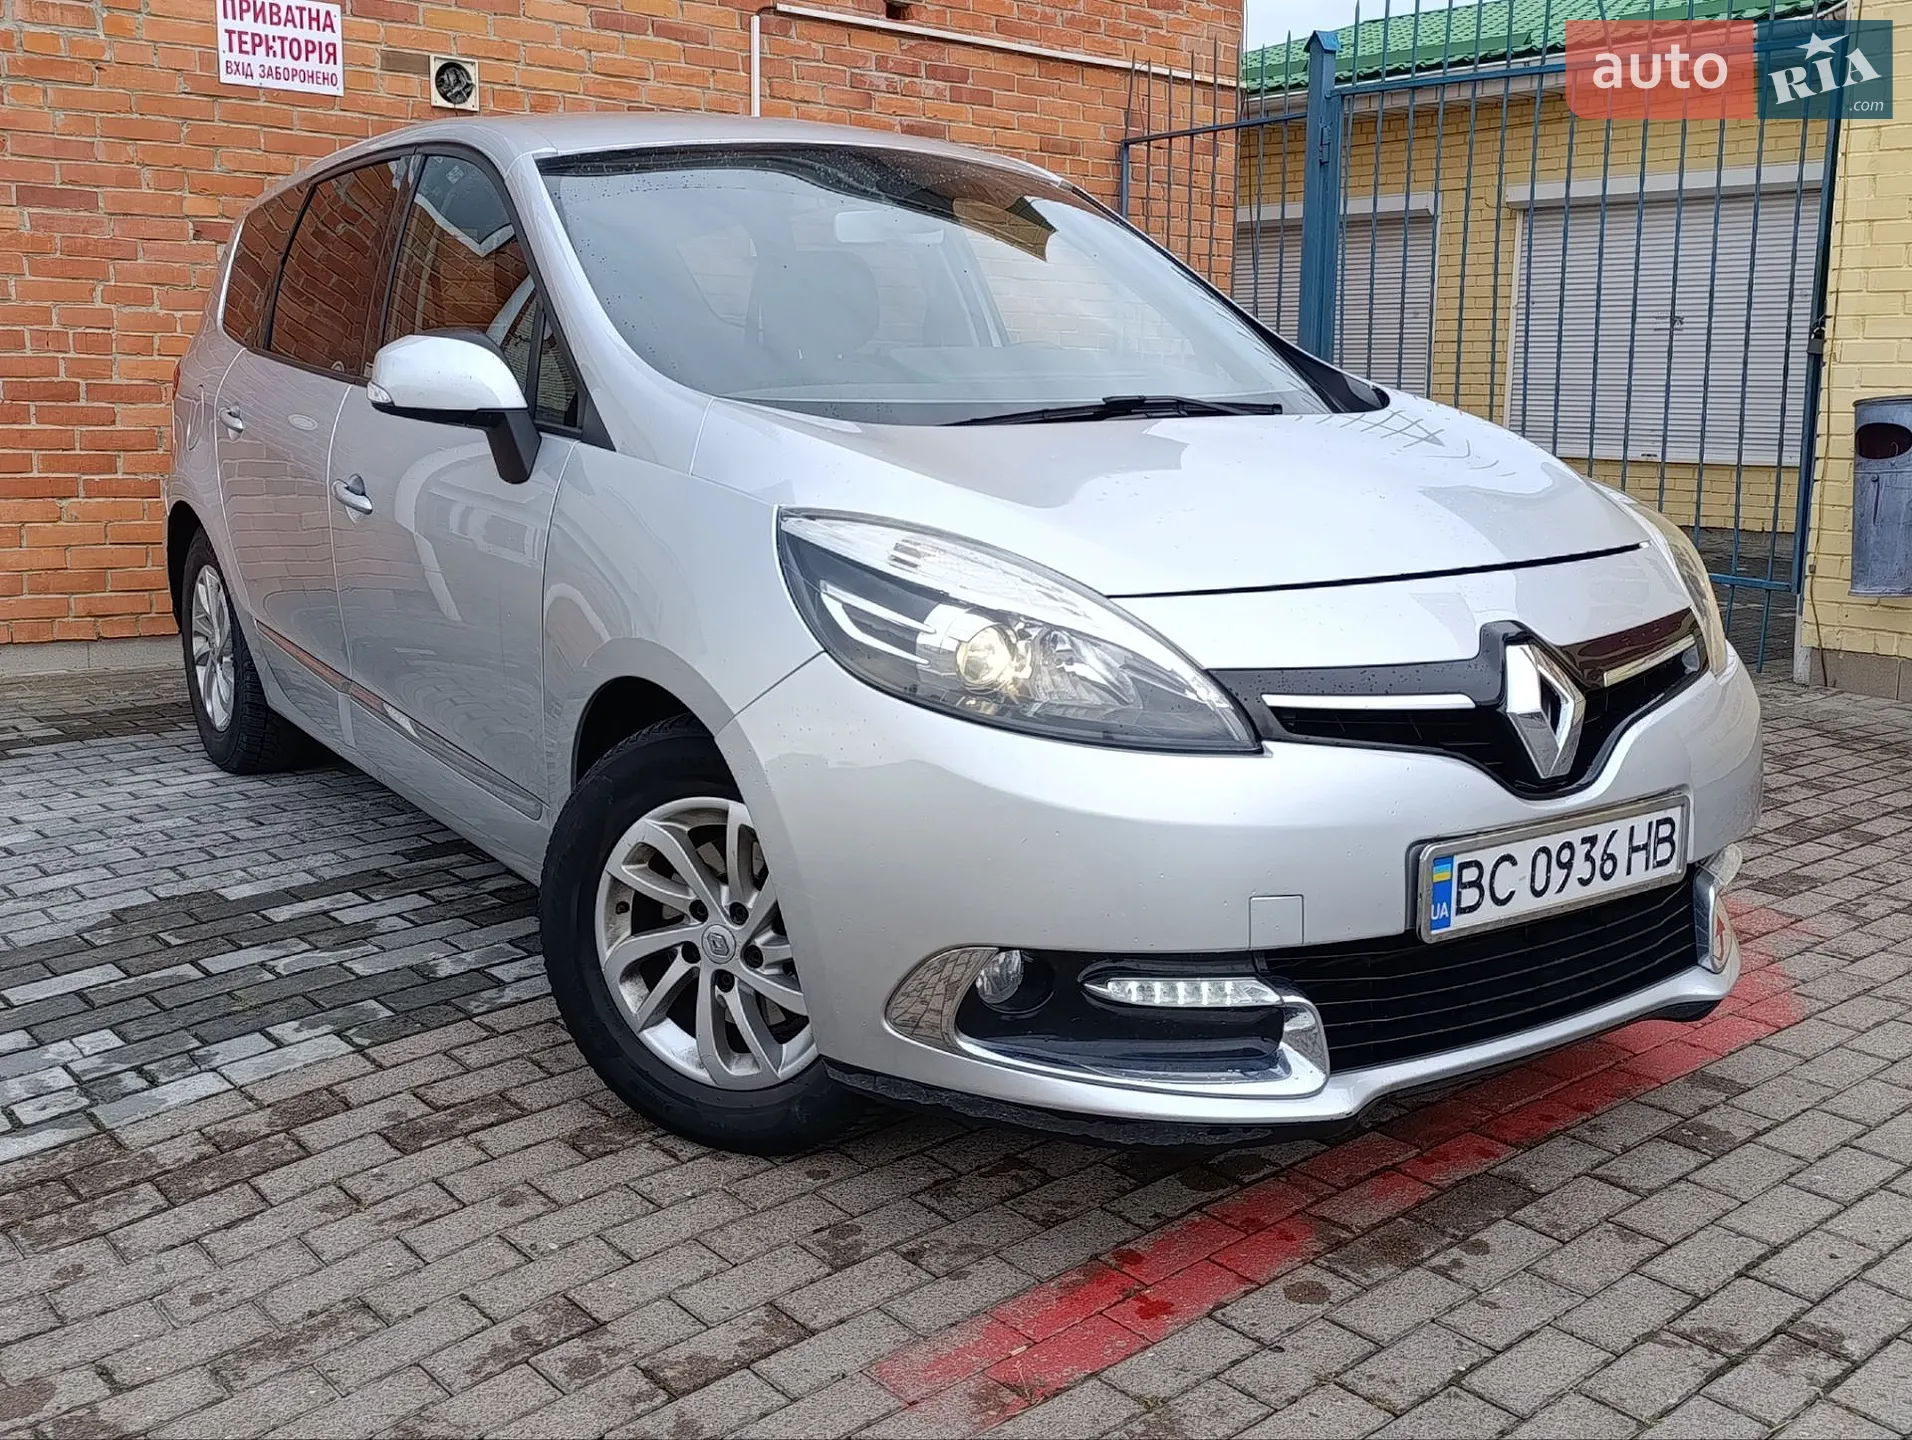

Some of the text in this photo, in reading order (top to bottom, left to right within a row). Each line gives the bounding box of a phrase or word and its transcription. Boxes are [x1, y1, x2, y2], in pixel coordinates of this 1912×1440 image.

[222, 0, 336, 34] ПРИВАТНА
[225, 60, 338, 87] ВХІД ЗАБОРОНЕНО
[1455, 817, 1676, 917] BC 0936 HB
[1431, 903, 1449, 920] UA
